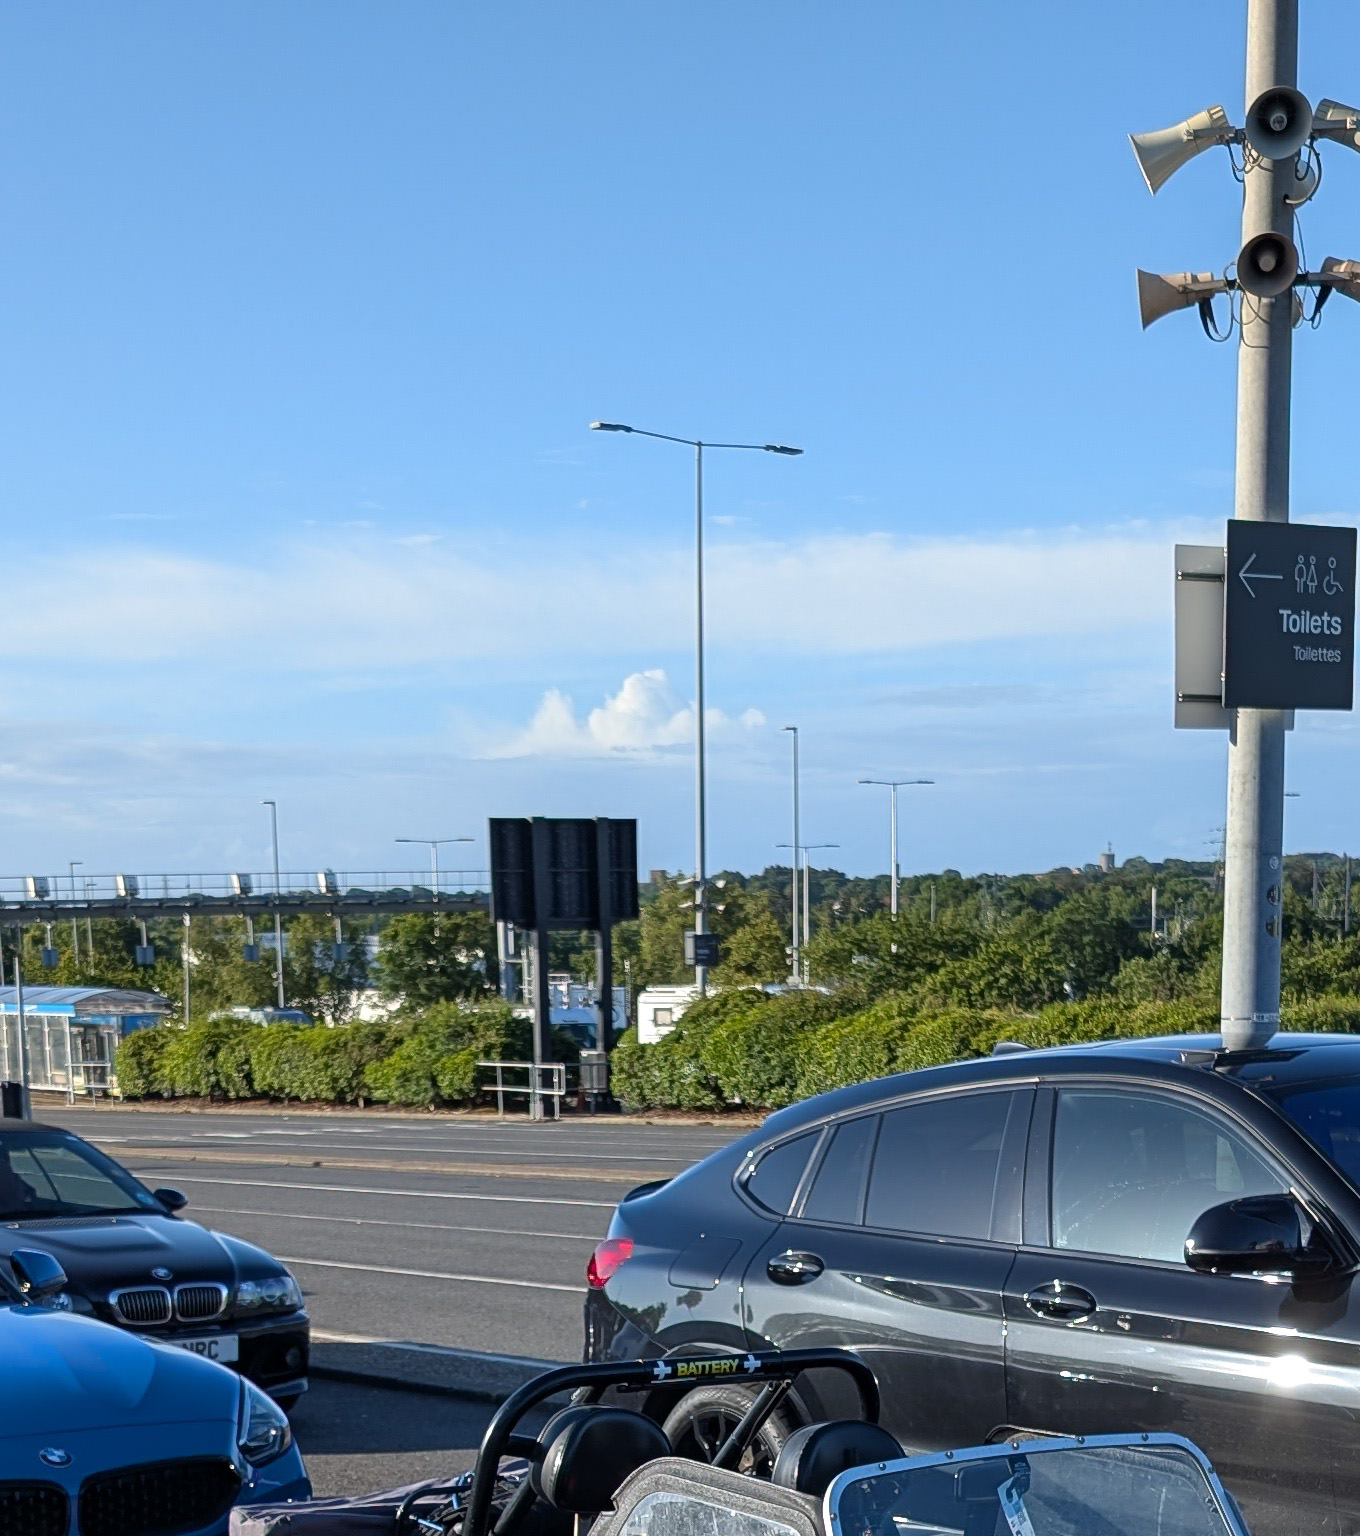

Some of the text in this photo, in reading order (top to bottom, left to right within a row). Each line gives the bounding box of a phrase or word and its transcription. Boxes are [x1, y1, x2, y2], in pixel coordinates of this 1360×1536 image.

[1278, 608, 1342, 636] Toilets
[1292, 645, 1342, 663] Toilettes
[676, 1358, 740, 1377] BATTERY
